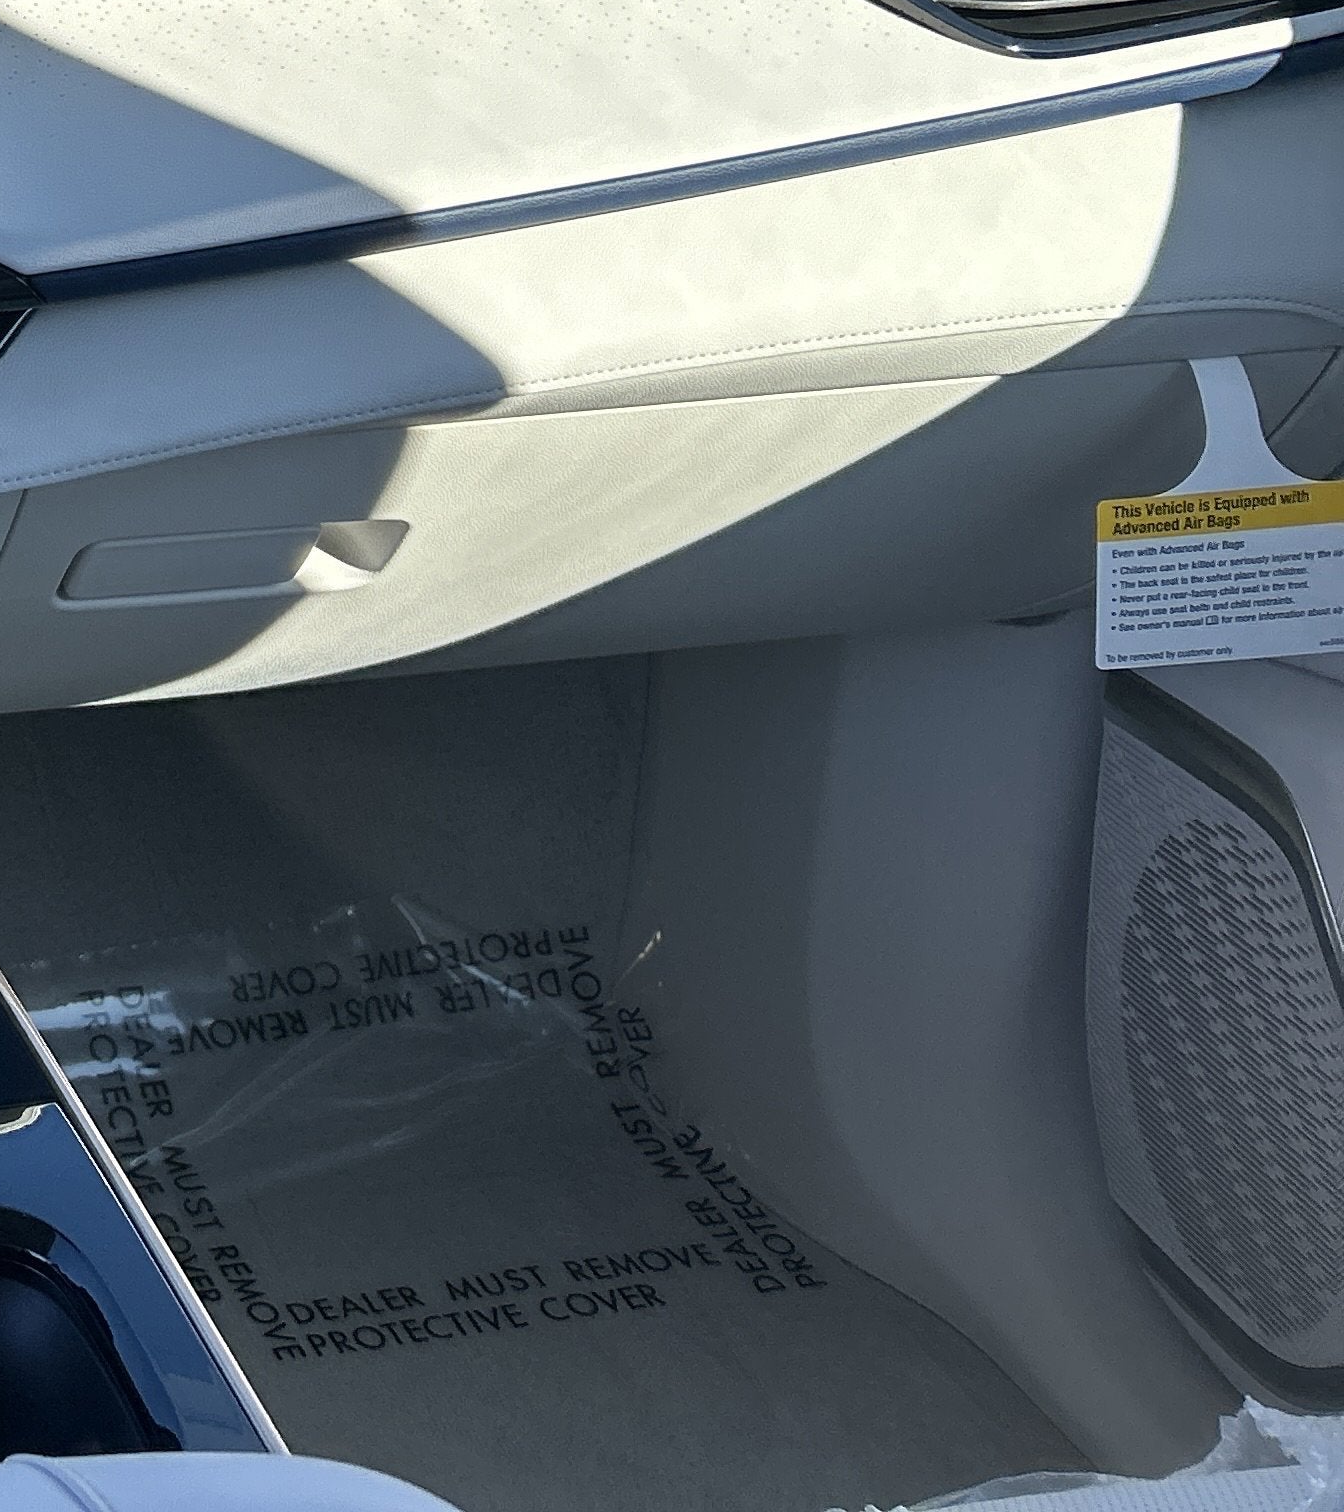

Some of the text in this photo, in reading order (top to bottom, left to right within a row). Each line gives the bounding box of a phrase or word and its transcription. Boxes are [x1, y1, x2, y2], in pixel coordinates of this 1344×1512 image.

[1112, 504, 1143, 519] This
[1144, 500, 1195, 517] Vehicle
[1213, 491, 1277, 512] Equipped
[1279, 489, 1310, 505] with
[1112, 513, 1241, 536] Advanced Air Bags
[1112, 540, 1245, 559] Even with Advanced Air Bags
[1119, 565, 1158, 575] Children
[1159, 564, 1176, 572] can
[1178, 562, 1189, 571] be
[1218, 559, 1228, 567] or
[1119, 579, 1136, 589] The
[1138, 578, 1159, 588] back
[1161, 576, 1180, 587] seat
[1191, 574, 1204, 584] the
[1206, 572, 1232, 583] safest
[1234, 570, 1257, 582] place
[1258, 569, 1271, 578] for
[1119, 594, 1145, 604] Never
[1146, 592, 1161, 603] put
[1162, 593, 1169, 601] a
[1219, 585, 1240, 596] child
[1241, 584, 1261, 595] seat
[1272, 582, 1286, 591] the
[1118, 608, 1150, 618] Always
[1151, 607, 1168, 616] use
[1169, 604, 1188, 615] seat
[1189, 602, 1211, 613] belts
[1212, 601, 1229, 611] and
[1230, 599, 1252, 609] child
[1118, 622, 1136, 632] See
[1172, 617, 1204, 628] manual
[1221, 615, 1234, 624] for
[1235, 614, 1257, 623] more
[1258, 610, 1306, 621] information
[1307, 607, 1332, 617] about
[1106, 645, 1234, 663] To be removed by customer only
[227, 929, 553, 1004] PROTECTIVE COVER
[327, 990, 417, 1032] MUST
[167, 1008, 309, 1057] REMOVE
[559, 925, 786, 1294] DEALER MUST REMOVE
[75, 988, 223, 1304] PROTECTIVE COVER
[118, 985, 307, 1361] DEALER MUST REMOVE
[672, 1122, 828, 1290] PROTECTIVE
[285, 1241, 721, 1326] DEALER MUST REMOVE
[305, 1282, 667, 1358] PROTECTIVE COVER
